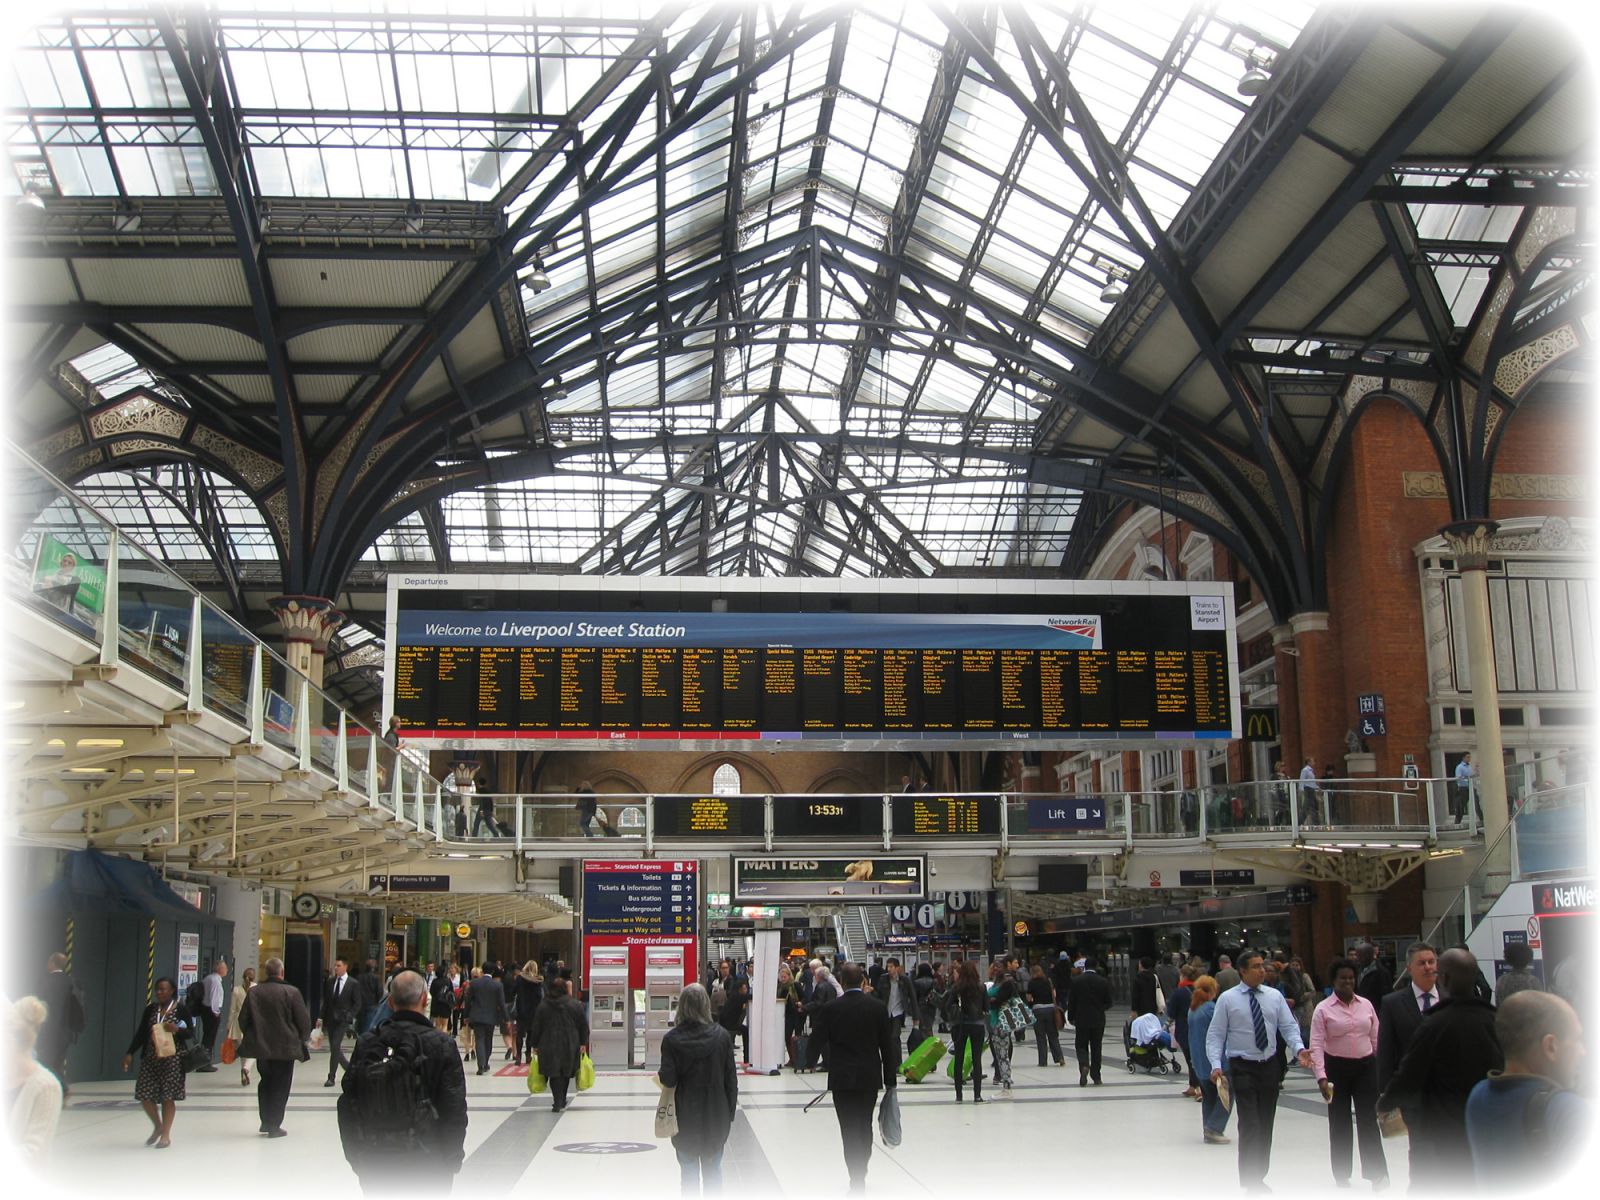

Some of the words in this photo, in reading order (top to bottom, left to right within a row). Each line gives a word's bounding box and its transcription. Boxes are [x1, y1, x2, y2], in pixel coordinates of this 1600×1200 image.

[425, 623, 482, 636] Welcome
[485, 624, 498, 636] to
[500, 622, 574, 640] Liverpool
[576, 622, 624, 637] Street
[628, 622, 686, 638] Station
[1048, 808, 1066, 819] Lift
[744, 860, 818, 870] MATTERS
[627, 936, 662, 944] Stansted
